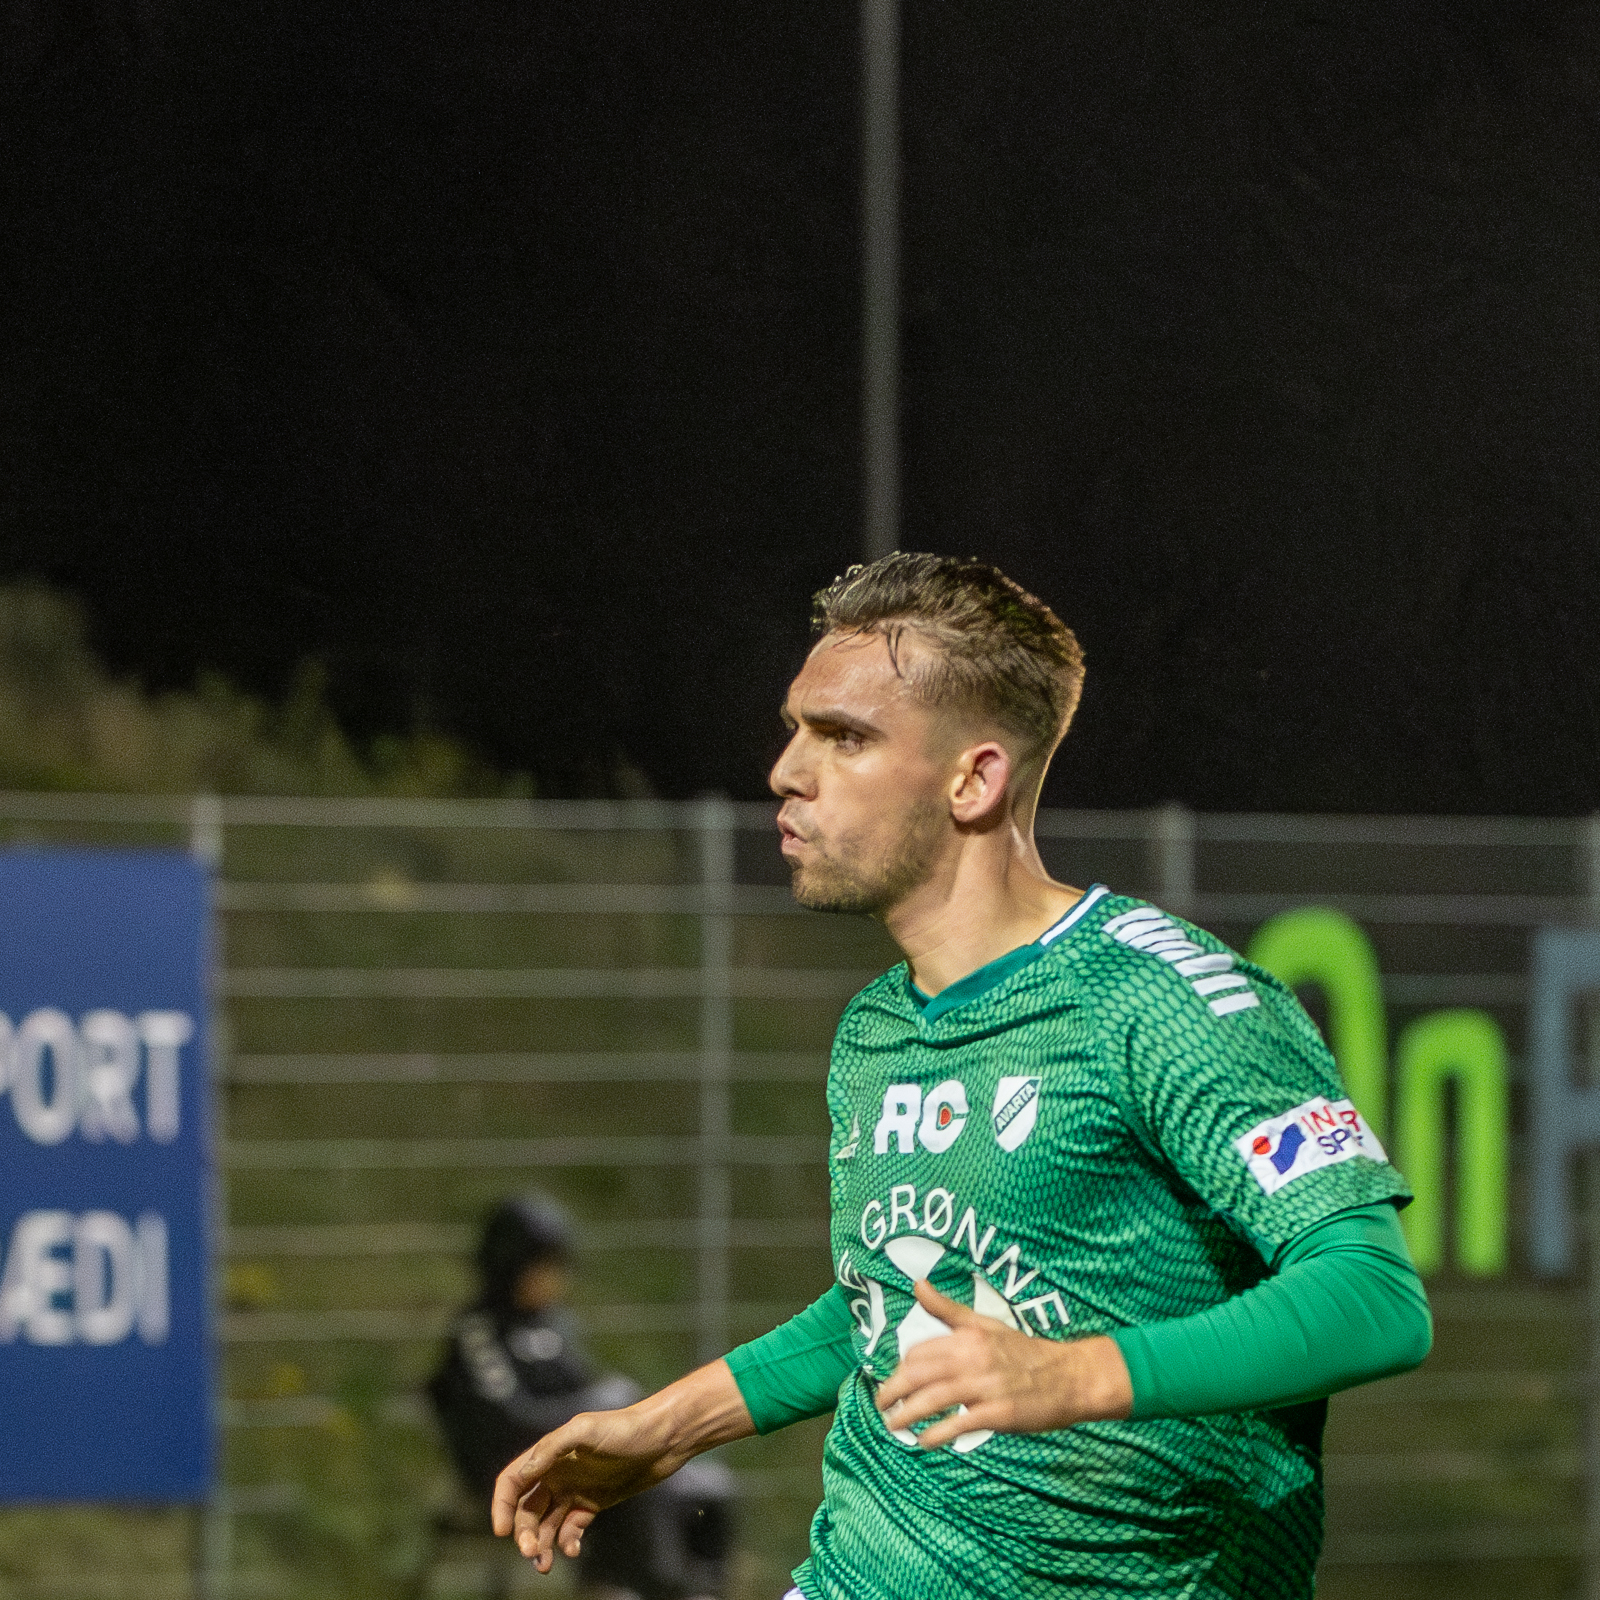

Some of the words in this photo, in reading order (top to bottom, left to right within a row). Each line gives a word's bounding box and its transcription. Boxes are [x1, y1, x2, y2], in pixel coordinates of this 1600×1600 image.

[874, 1080, 970, 1154] RC
[996, 1083, 1036, 1131] AVARTA
[860, 1183, 1070, 1338] GRØNNE
